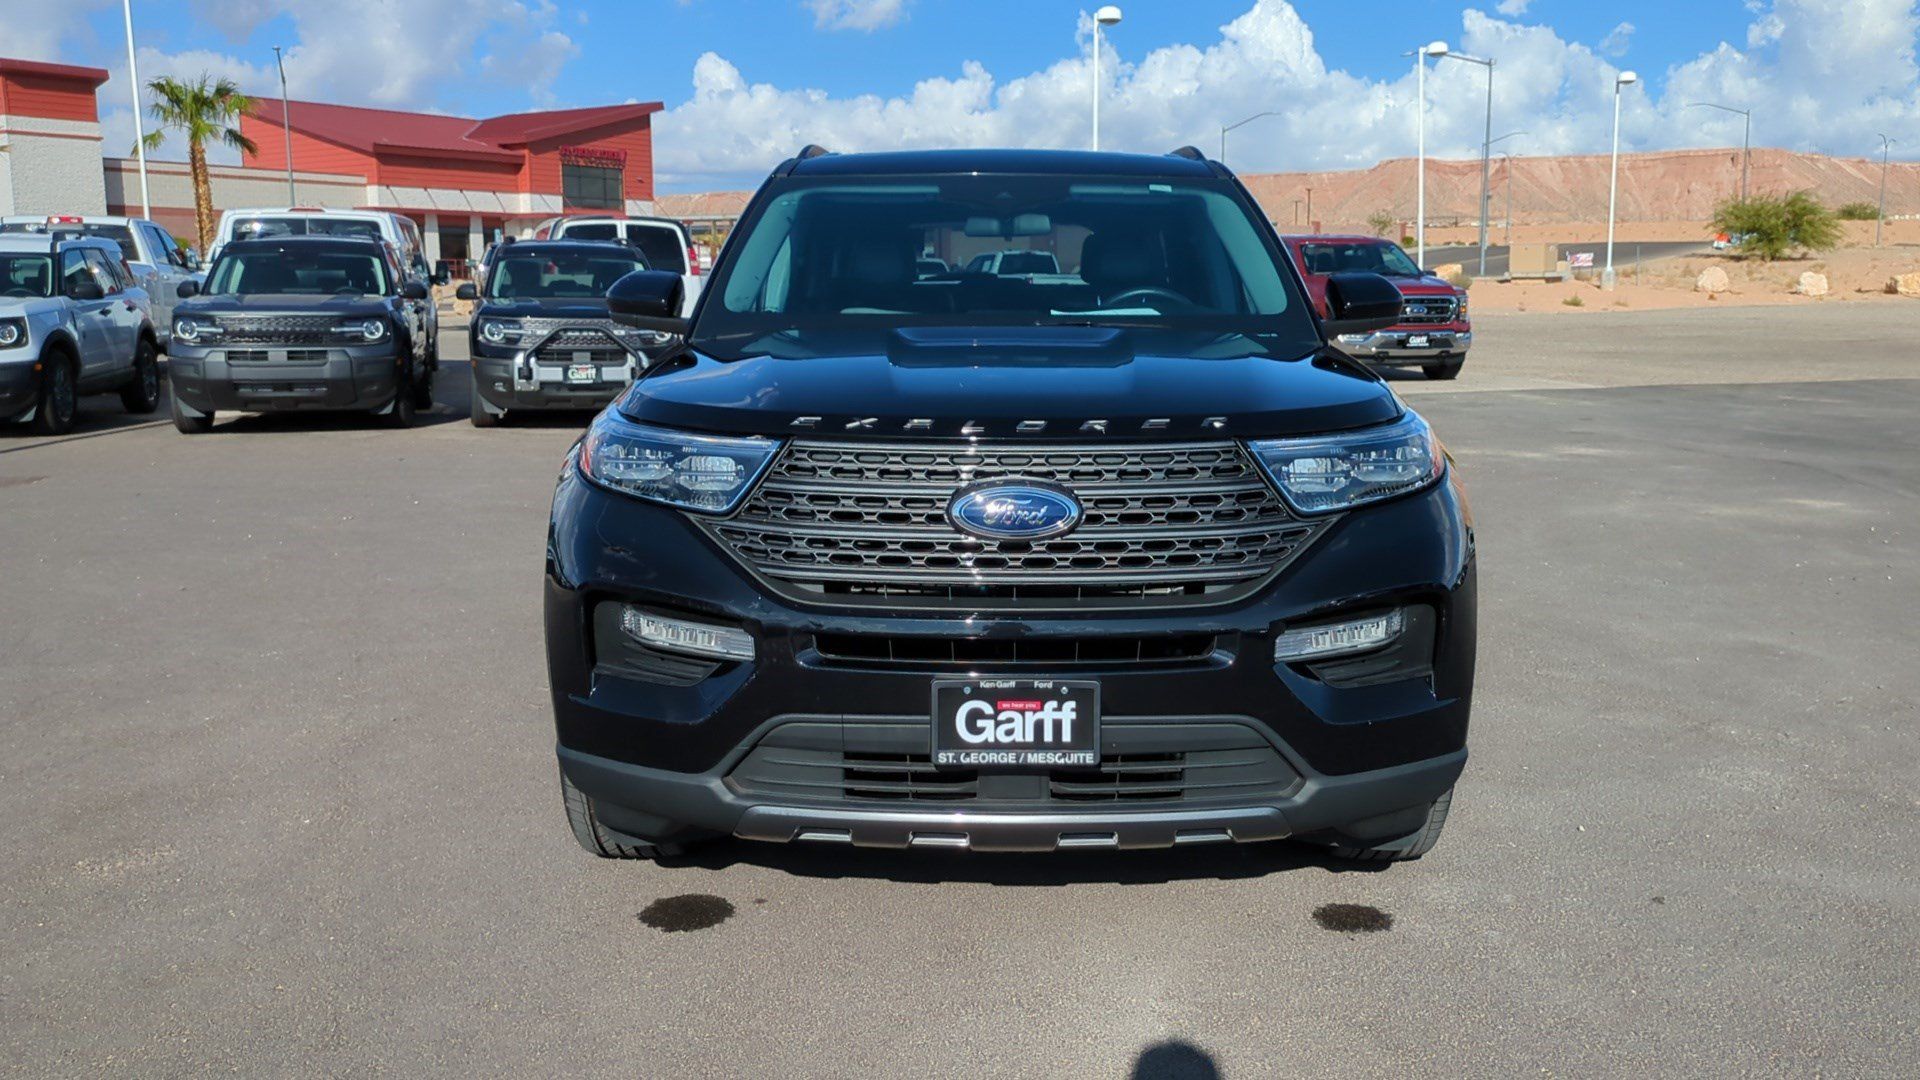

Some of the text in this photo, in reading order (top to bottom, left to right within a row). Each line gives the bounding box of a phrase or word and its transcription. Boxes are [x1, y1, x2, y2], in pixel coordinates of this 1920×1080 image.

[568, 367, 597, 380] Garff
[789, 415, 1228, 435] EXPLORER
[982, 497, 1048, 526] Ford
[1034, 680, 1053, 689] Ford
[955, 700, 1076, 744] Garff
[938, 752, 956, 764] ST.
[960, 752, 1016, 764] GEORGE
[1027, 752, 1094, 764] MESQUITE
